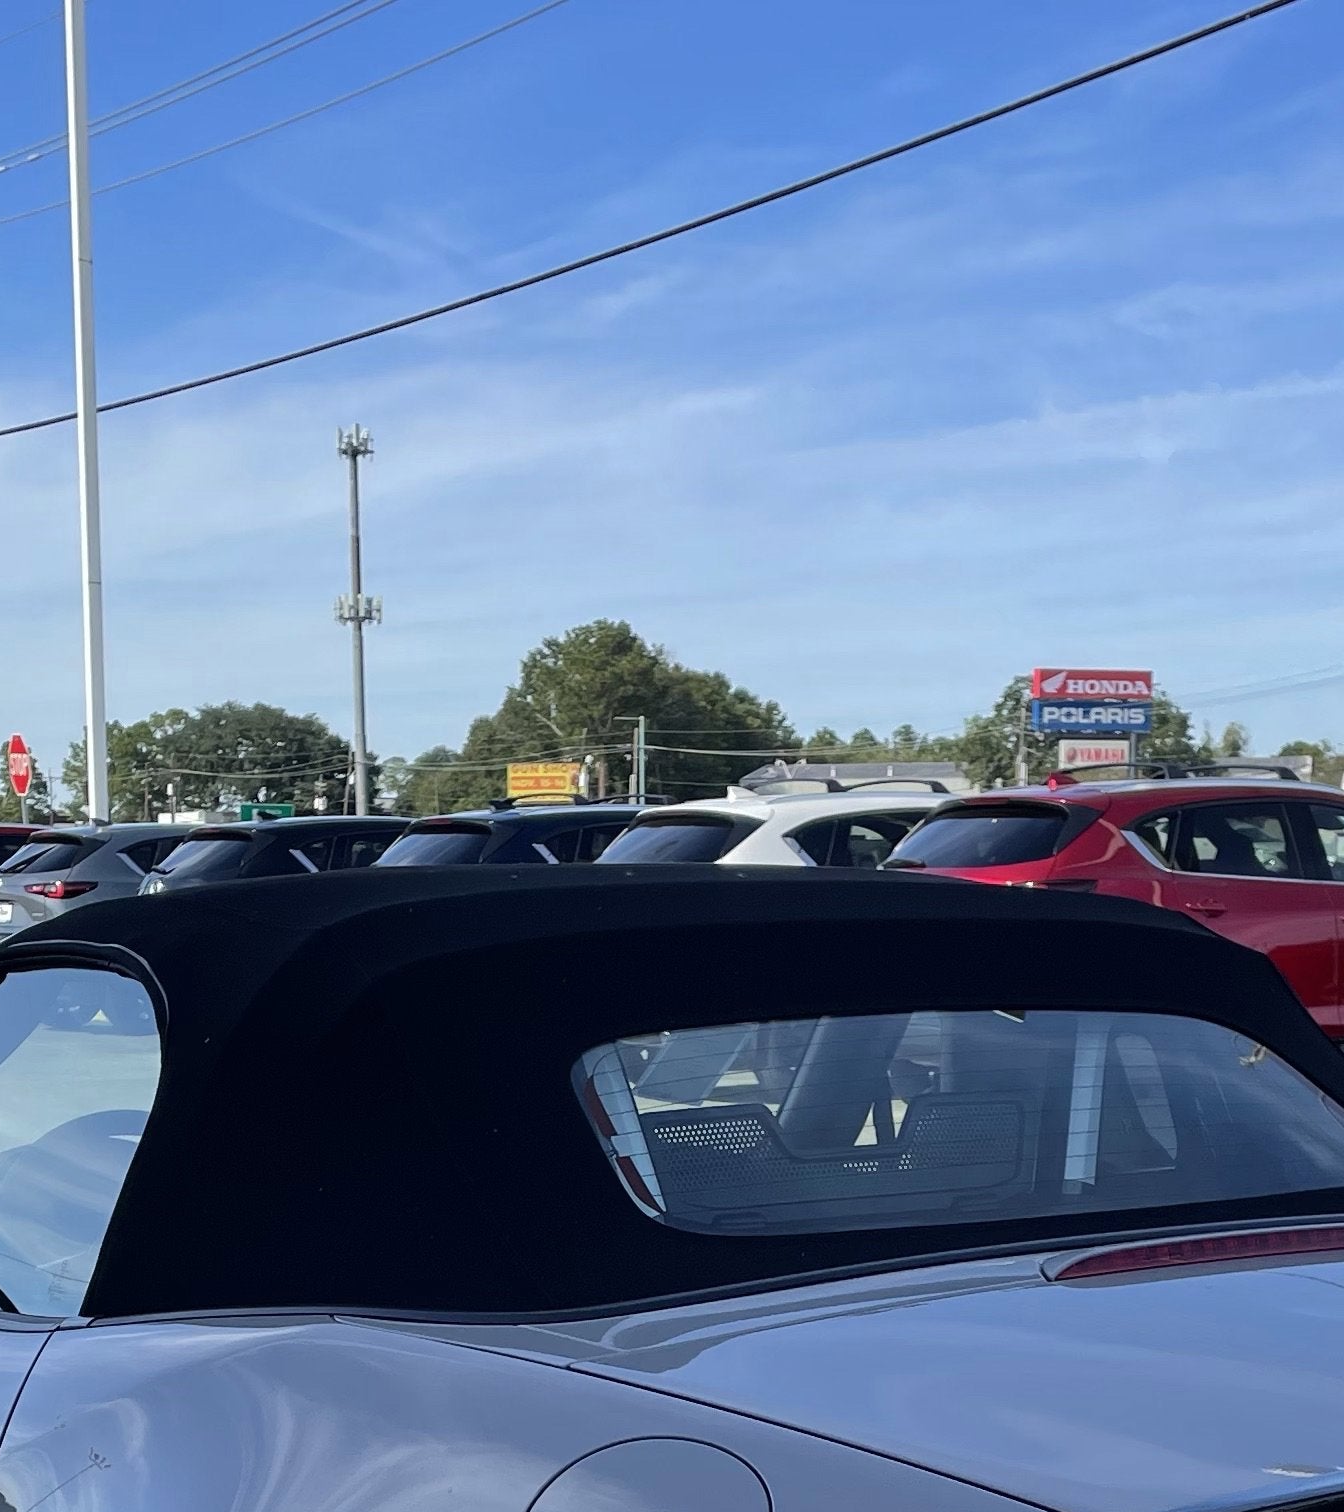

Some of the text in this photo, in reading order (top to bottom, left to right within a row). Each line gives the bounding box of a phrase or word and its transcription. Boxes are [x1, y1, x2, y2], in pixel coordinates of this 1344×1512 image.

[1065, 679, 1150, 695] HONDA
[1043, 707, 1146, 725] POLARIS
[9, 753, 28, 776] STOP
